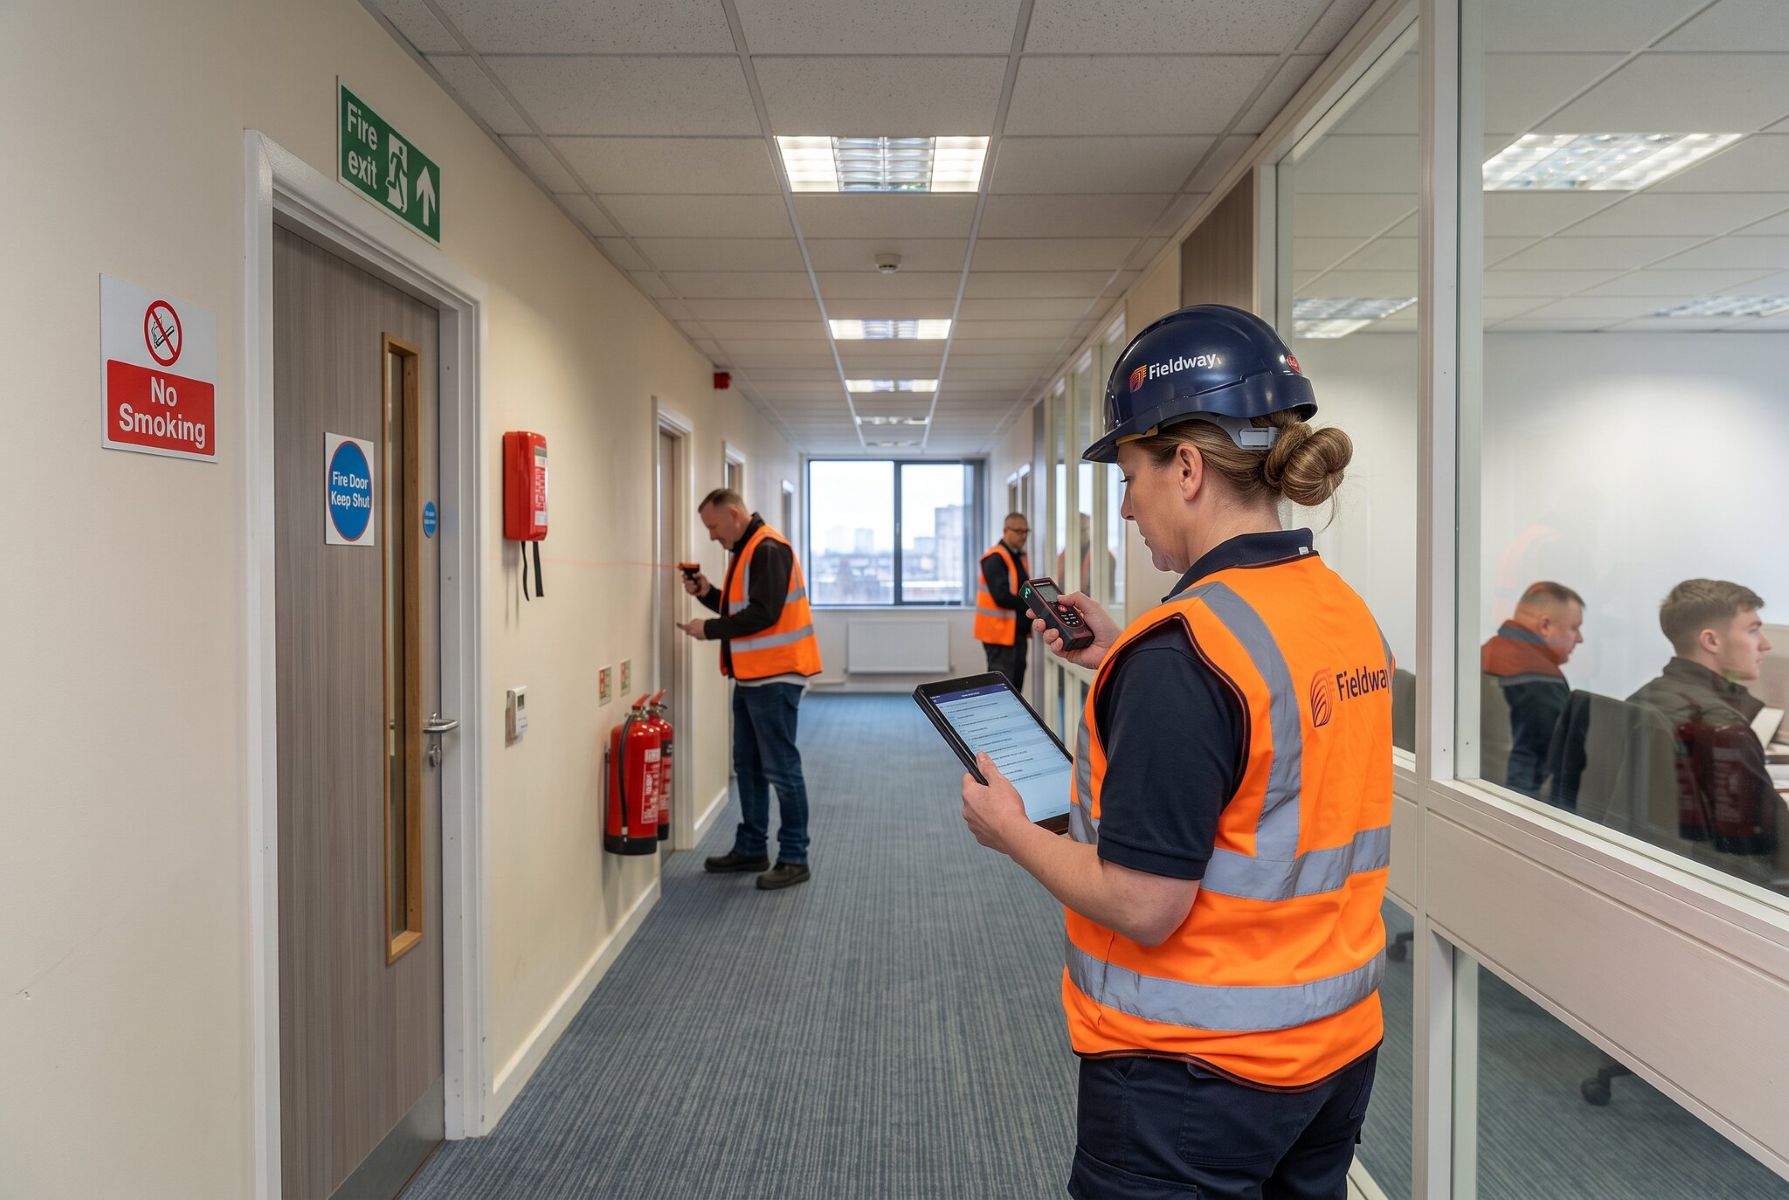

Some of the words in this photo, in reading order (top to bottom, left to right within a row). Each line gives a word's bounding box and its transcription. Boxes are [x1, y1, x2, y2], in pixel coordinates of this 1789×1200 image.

[347, 101, 378, 150] Fire
[348, 150, 378, 190] exit
[1149, 353, 1217, 380] Fieldway
[151, 376, 177, 407] No
[119, 402, 206, 449] Smoking
[332, 471, 348, 487] Fire
[349, 474, 368, 490] Door
[331, 491, 351, 510] Keep
[352, 493, 370, 509] Shut
